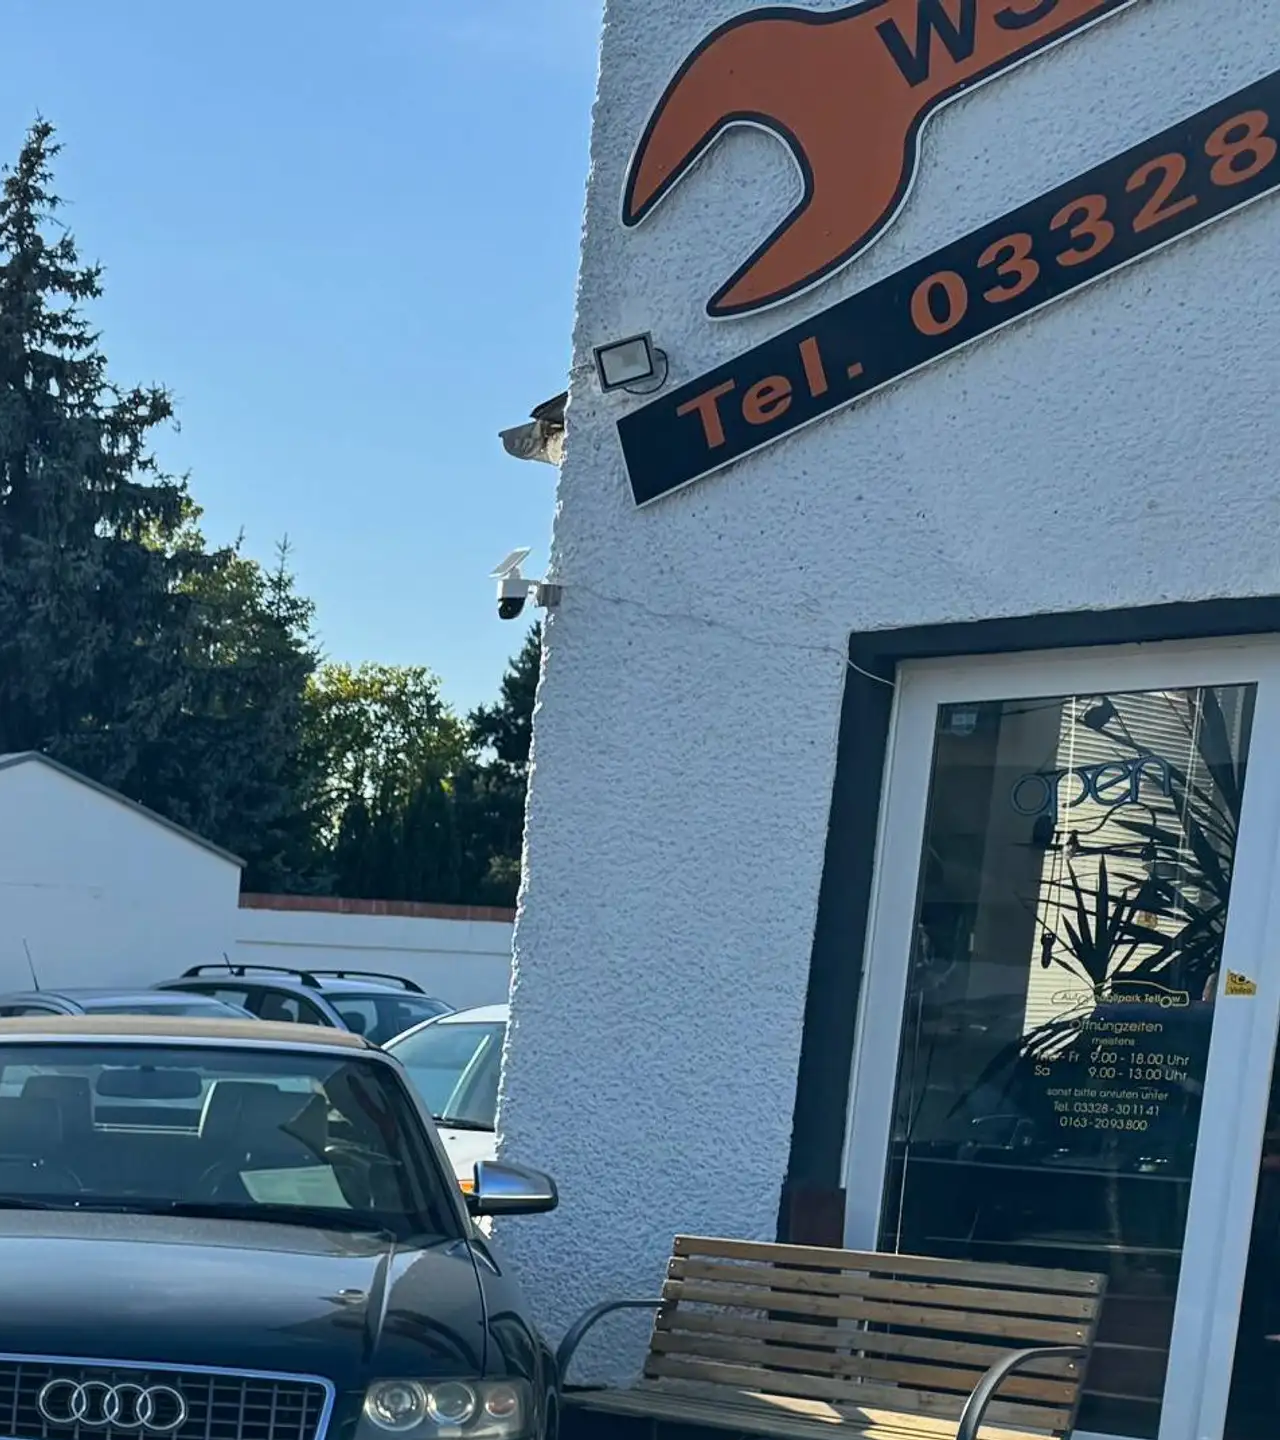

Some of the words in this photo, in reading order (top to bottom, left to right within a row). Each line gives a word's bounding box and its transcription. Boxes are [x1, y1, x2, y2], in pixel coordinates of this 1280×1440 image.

[677, 337, 864, 449] Tel.
[911, 109, 1278, 337] 03328
[1130, 1053, 1163, 1065] 18.00
[1167, 1053, 1190, 1066] Uhr
[1034, 1065, 1051, 1076] Sa
[1088, 1067, 1115, 1078] 9.00
[1165, 1069, 1188, 1081] Uhr
[1141, 1089, 1169, 1101] unter
